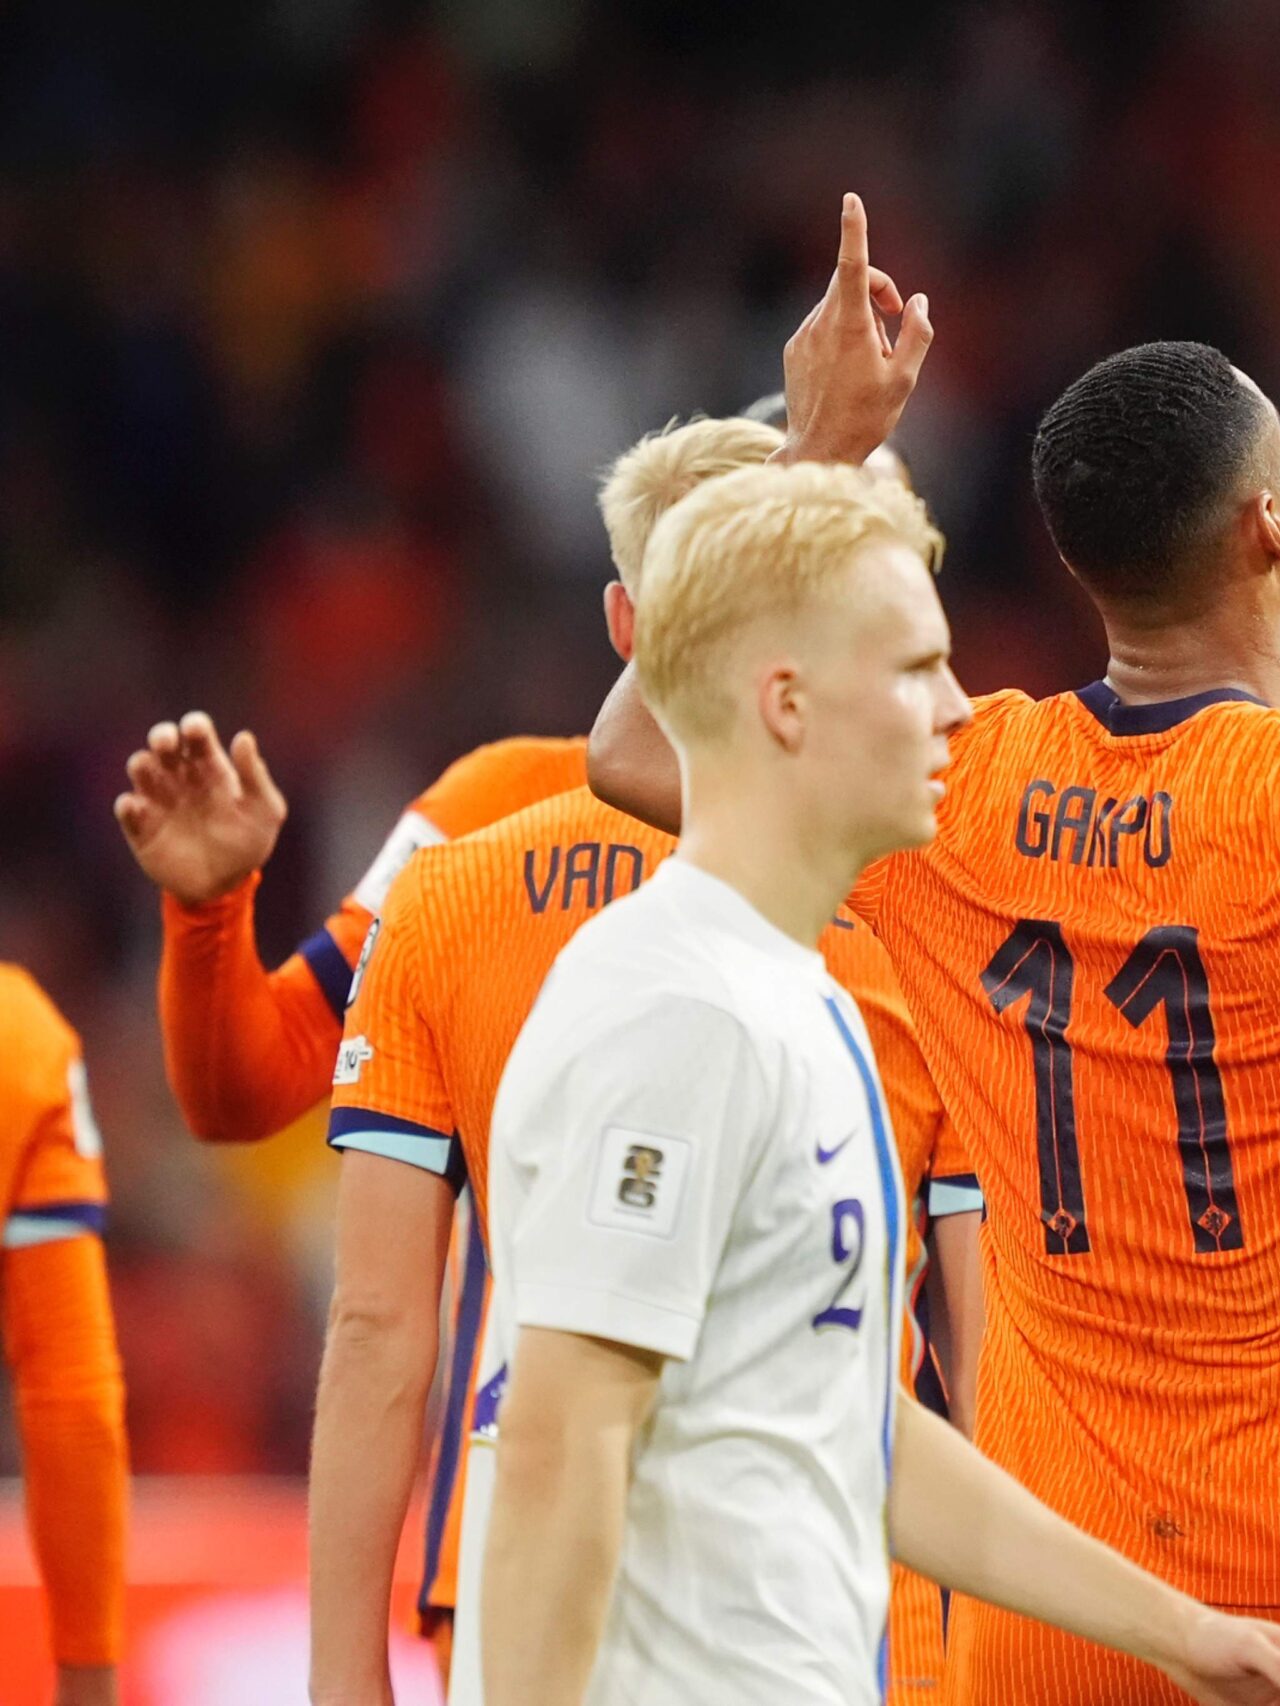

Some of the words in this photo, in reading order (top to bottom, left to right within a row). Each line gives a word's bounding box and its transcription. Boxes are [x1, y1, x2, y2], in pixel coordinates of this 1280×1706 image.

[524, 841, 643, 914] VAN
[1015, 779, 1173, 868] GAKPO
[979, 918, 1245, 1255] 11
[811, 1198, 866, 1331] 2
